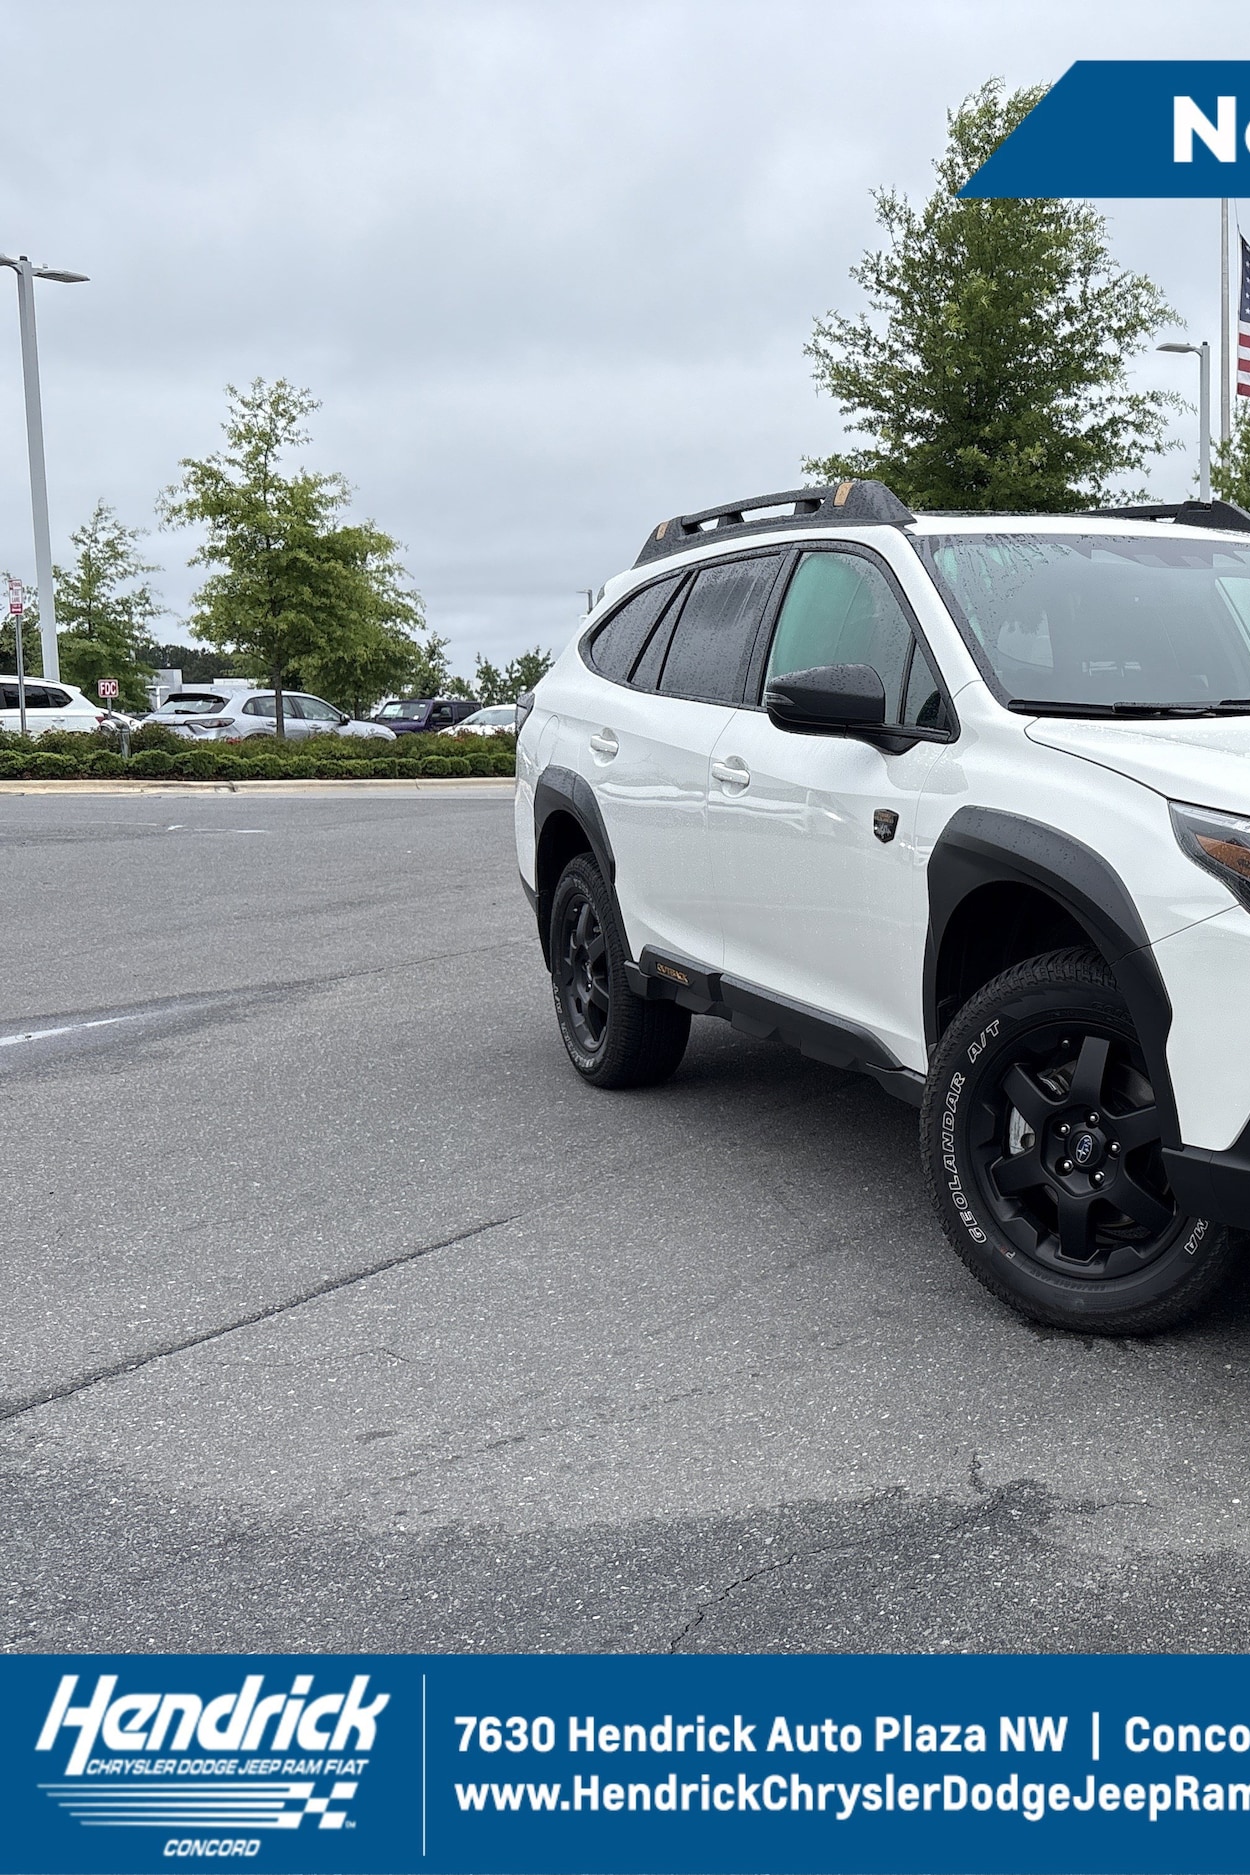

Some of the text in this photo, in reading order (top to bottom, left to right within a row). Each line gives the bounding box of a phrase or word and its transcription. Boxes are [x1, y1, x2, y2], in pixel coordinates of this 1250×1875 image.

[100, 682, 116, 695] FDC
[942, 1019, 1000, 1244] GEOLANDAR A/T
